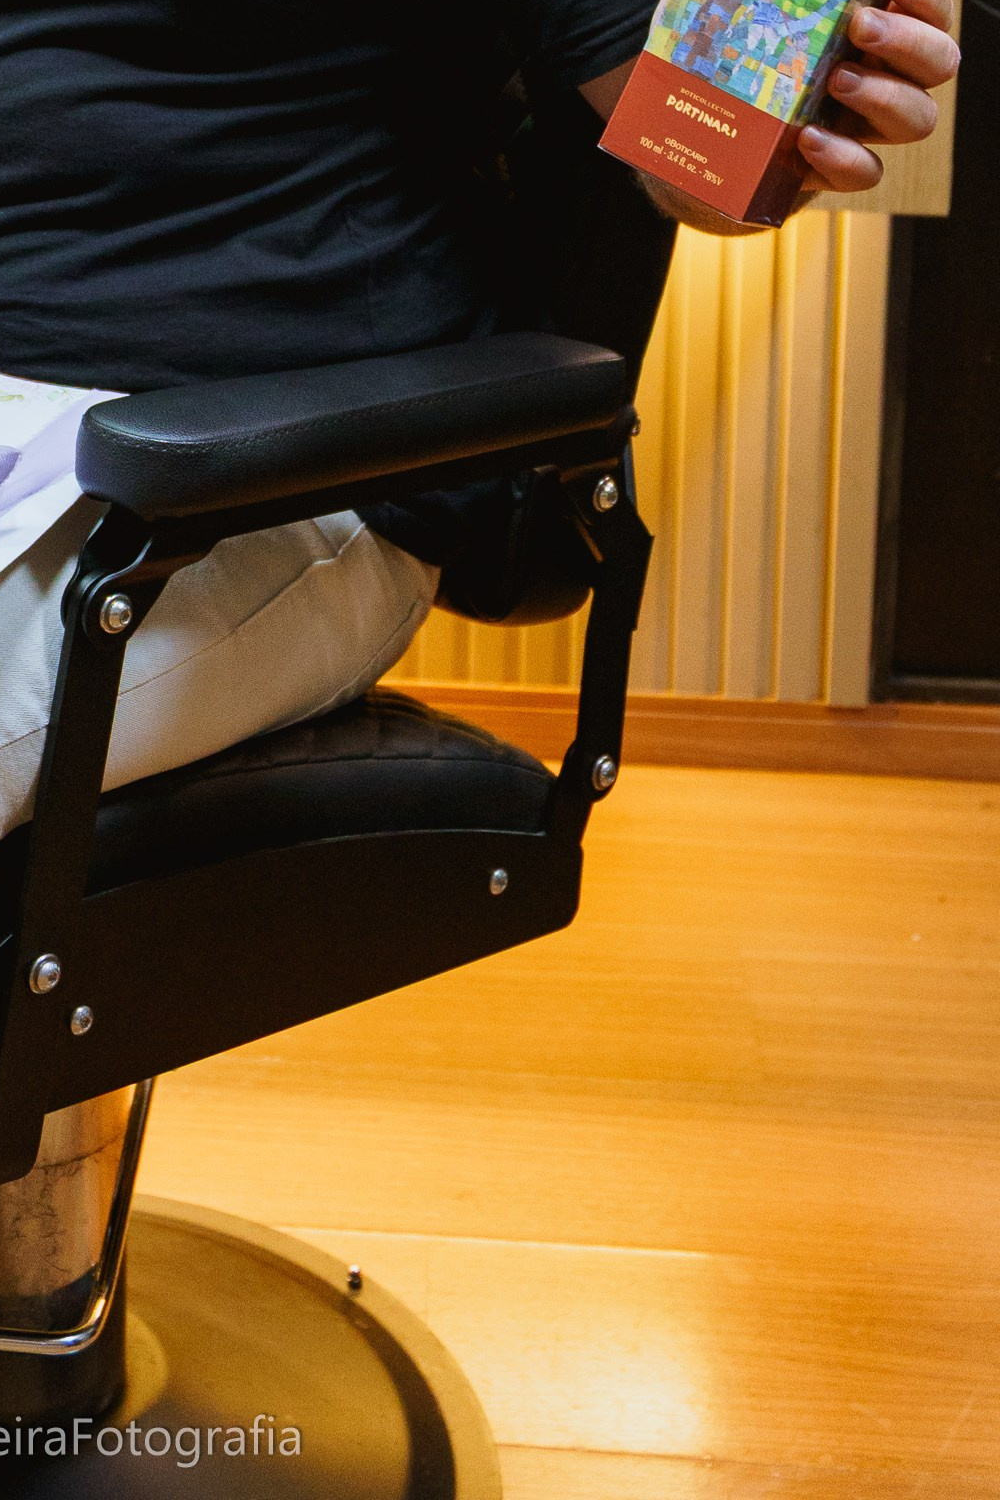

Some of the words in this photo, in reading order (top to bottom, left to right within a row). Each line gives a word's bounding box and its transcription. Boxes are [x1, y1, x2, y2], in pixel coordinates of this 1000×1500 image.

[665, 94, 738, 138] PORTINARI
[680, 87, 736, 120] BOTICOLLECTION
[640, 136, 654, 149] 100
[653, 145, 664, 155] ml
[667, 150, 680, 163] 3.4
[686, 163, 697, 174] oz.
